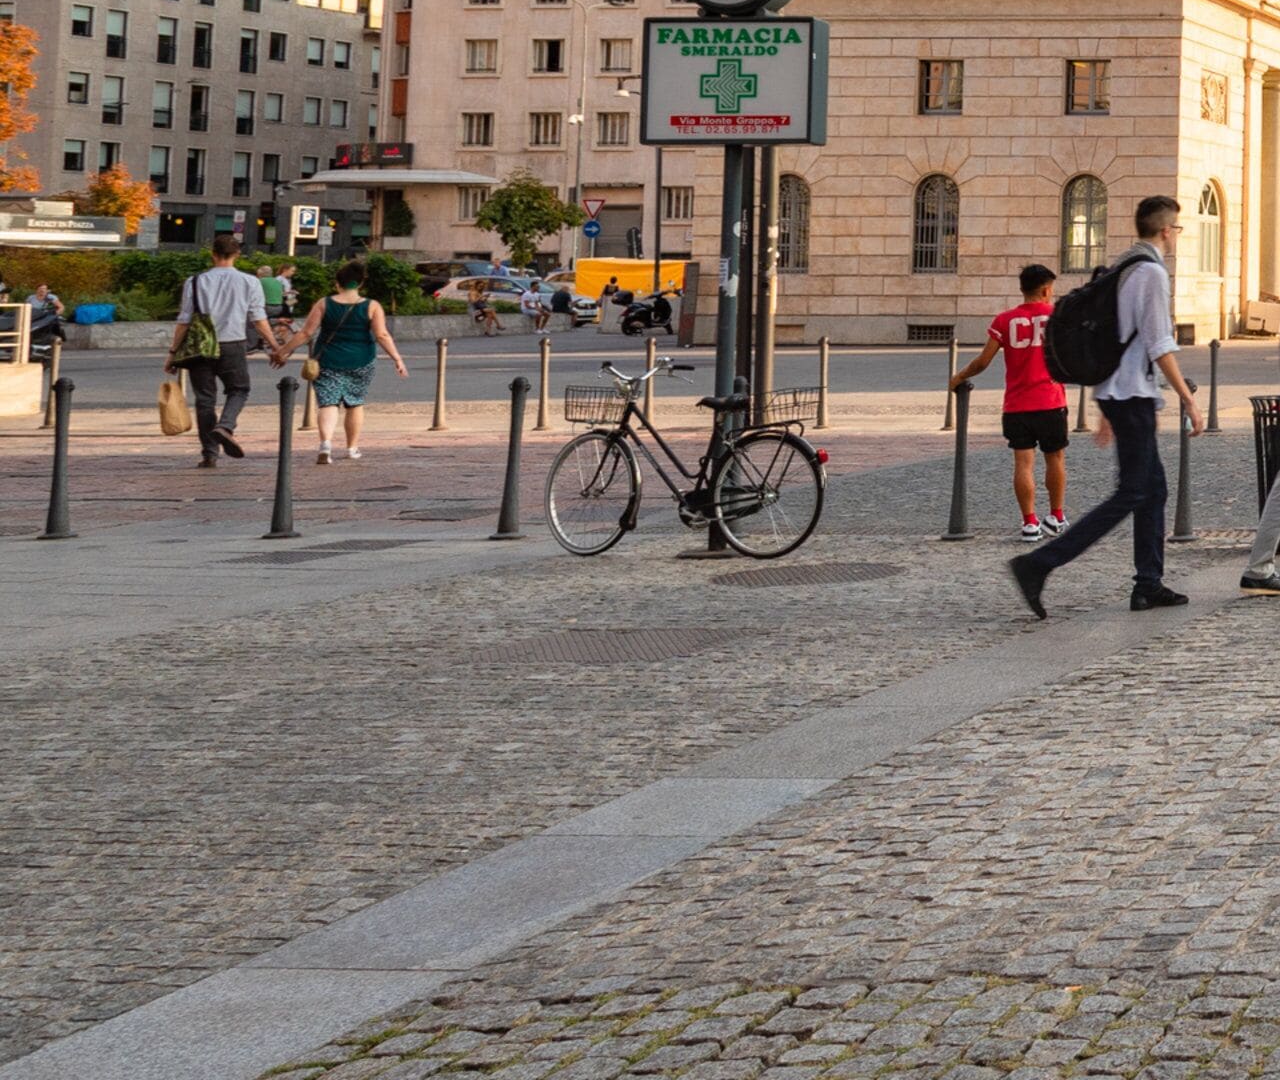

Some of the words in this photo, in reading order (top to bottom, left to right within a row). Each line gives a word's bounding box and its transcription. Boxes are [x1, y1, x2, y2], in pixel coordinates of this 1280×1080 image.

[657, 27, 802, 44] FARMACIA
[680, 46, 778, 57] SMERALDO
[680, 117, 696, 125] Via
[700, 117, 733, 125] Monte
[780, 117, 787, 125] 7
[677, 126, 699, 134] TEL.
